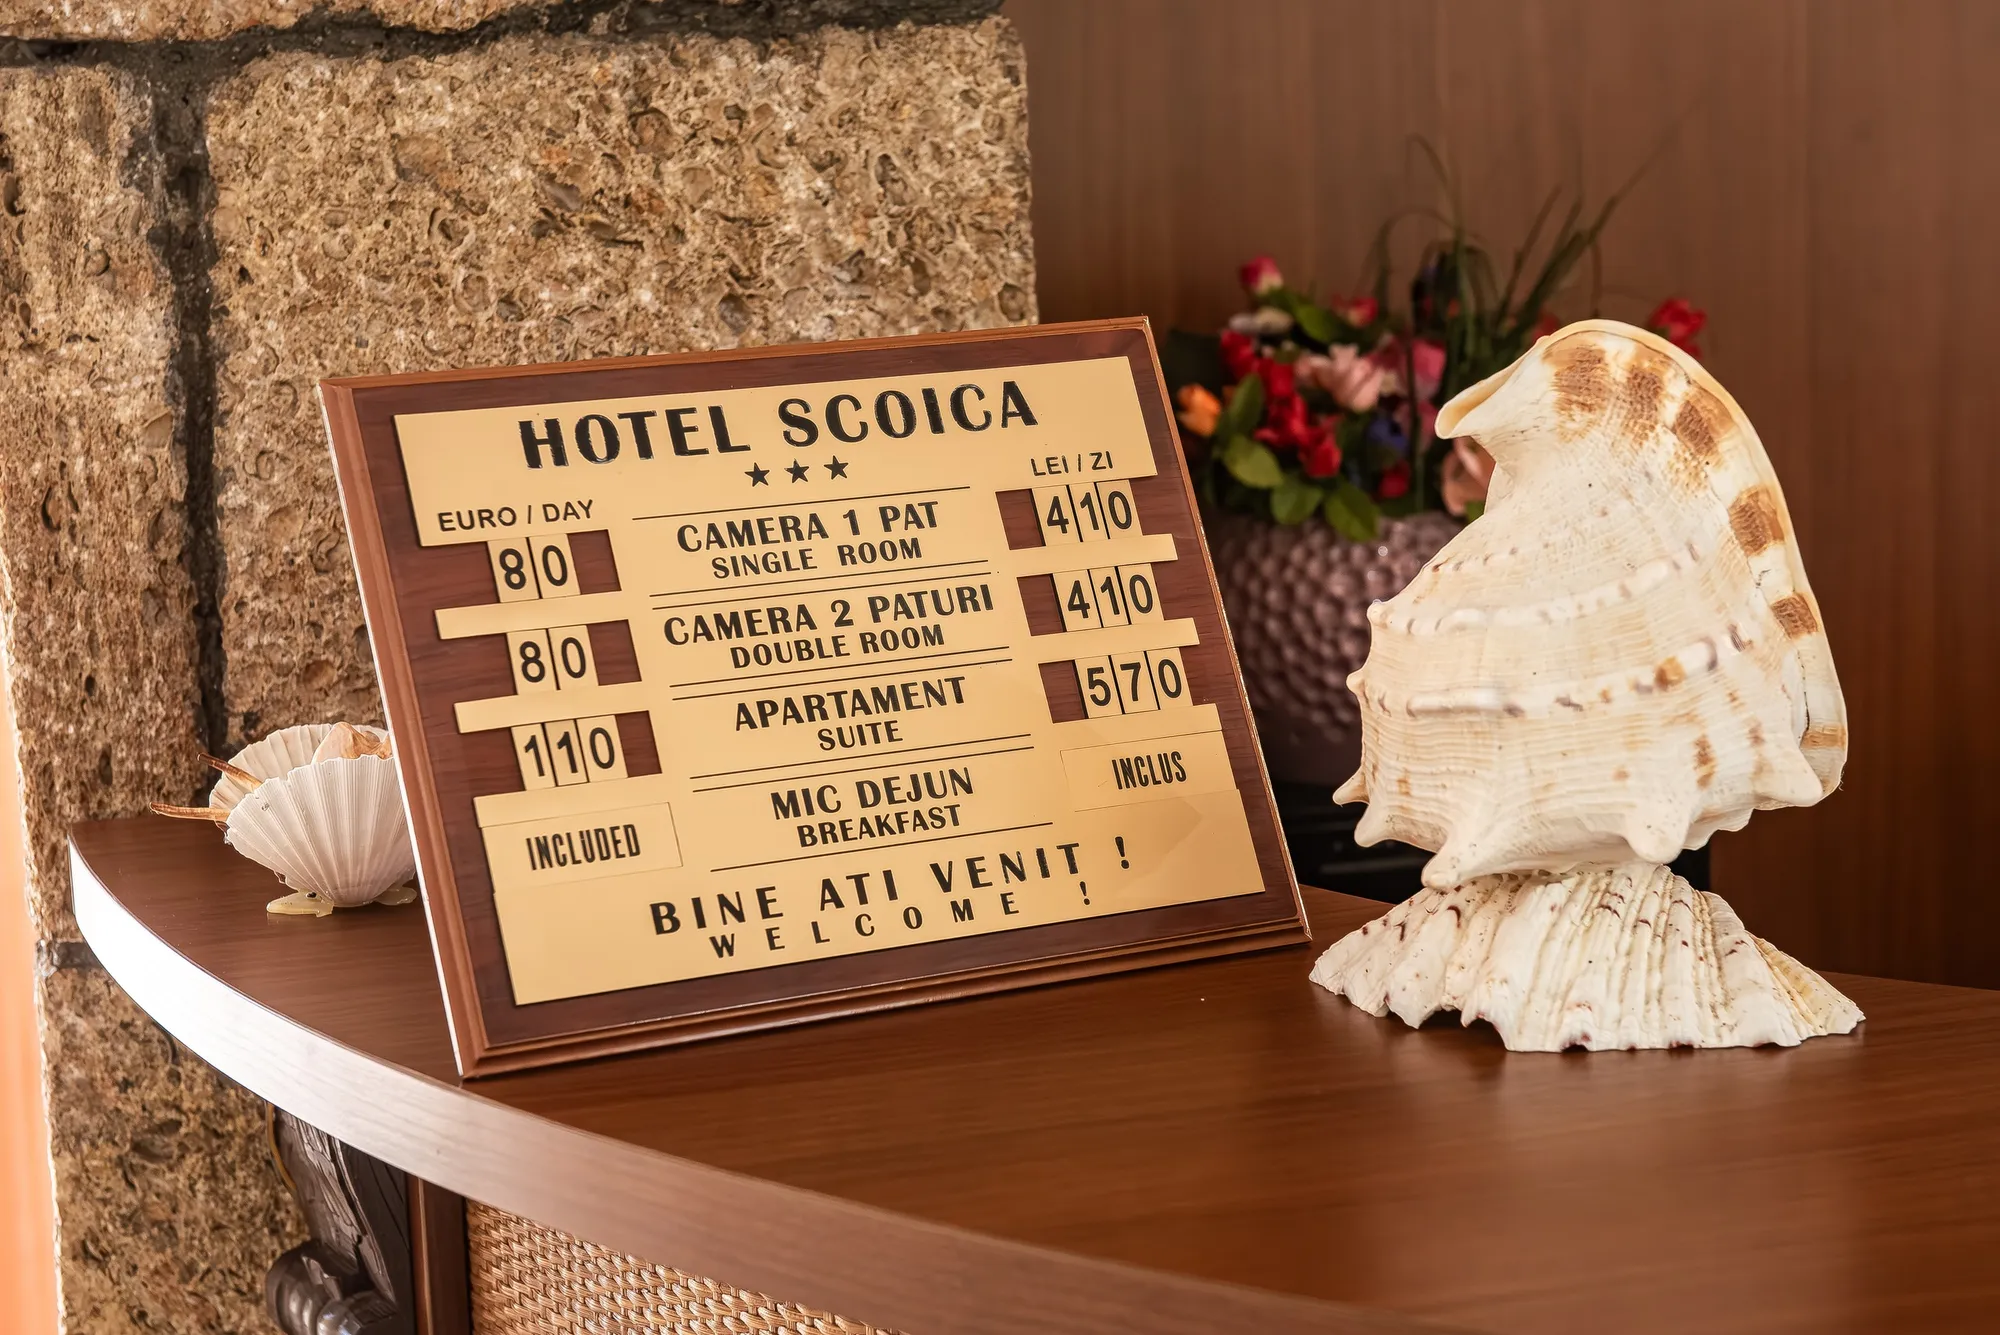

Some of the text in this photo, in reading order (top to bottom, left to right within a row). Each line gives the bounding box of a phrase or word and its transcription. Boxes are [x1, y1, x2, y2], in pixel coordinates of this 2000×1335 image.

[518, 380, 1038, 469] HOTEL SCOICA
[1031, 451, 1113, 476] LEI / ZI
[438, 500, 593, 532] EURO / DAY
[677, 501, 939, 552] CAMERA 1 PAT
[1046, 490, 1132, 534] 410
[499, 544, 568, 590] 80
[712, 537, 922, 579] SINGLE ROOM
[664, 584, 994, 646] CAMERA 2 PATURI
[1067, 574, 1153, 618] 410
[521, 637, 587, 683] 80
[731, 624, 945, 669] DOUBLE ROOM
[735, 676, 965, 731] APARTAMENT
[1088, 659, 1182, 706] 570
[524, 727, 615, 776] 110
[817, 721, 903, 750] SUITE
[771, 767, 974, 820] MIC DEJUN
[1112, 751, 1187, 790] INCLUS
[526, 823, 641, 871] INCLUDED
[797, 804, 960, 848] BREAKFAST
[650, 836, 1130, 935] BINE ATI VENIT !
[1080, 881, 1091, 906] !
